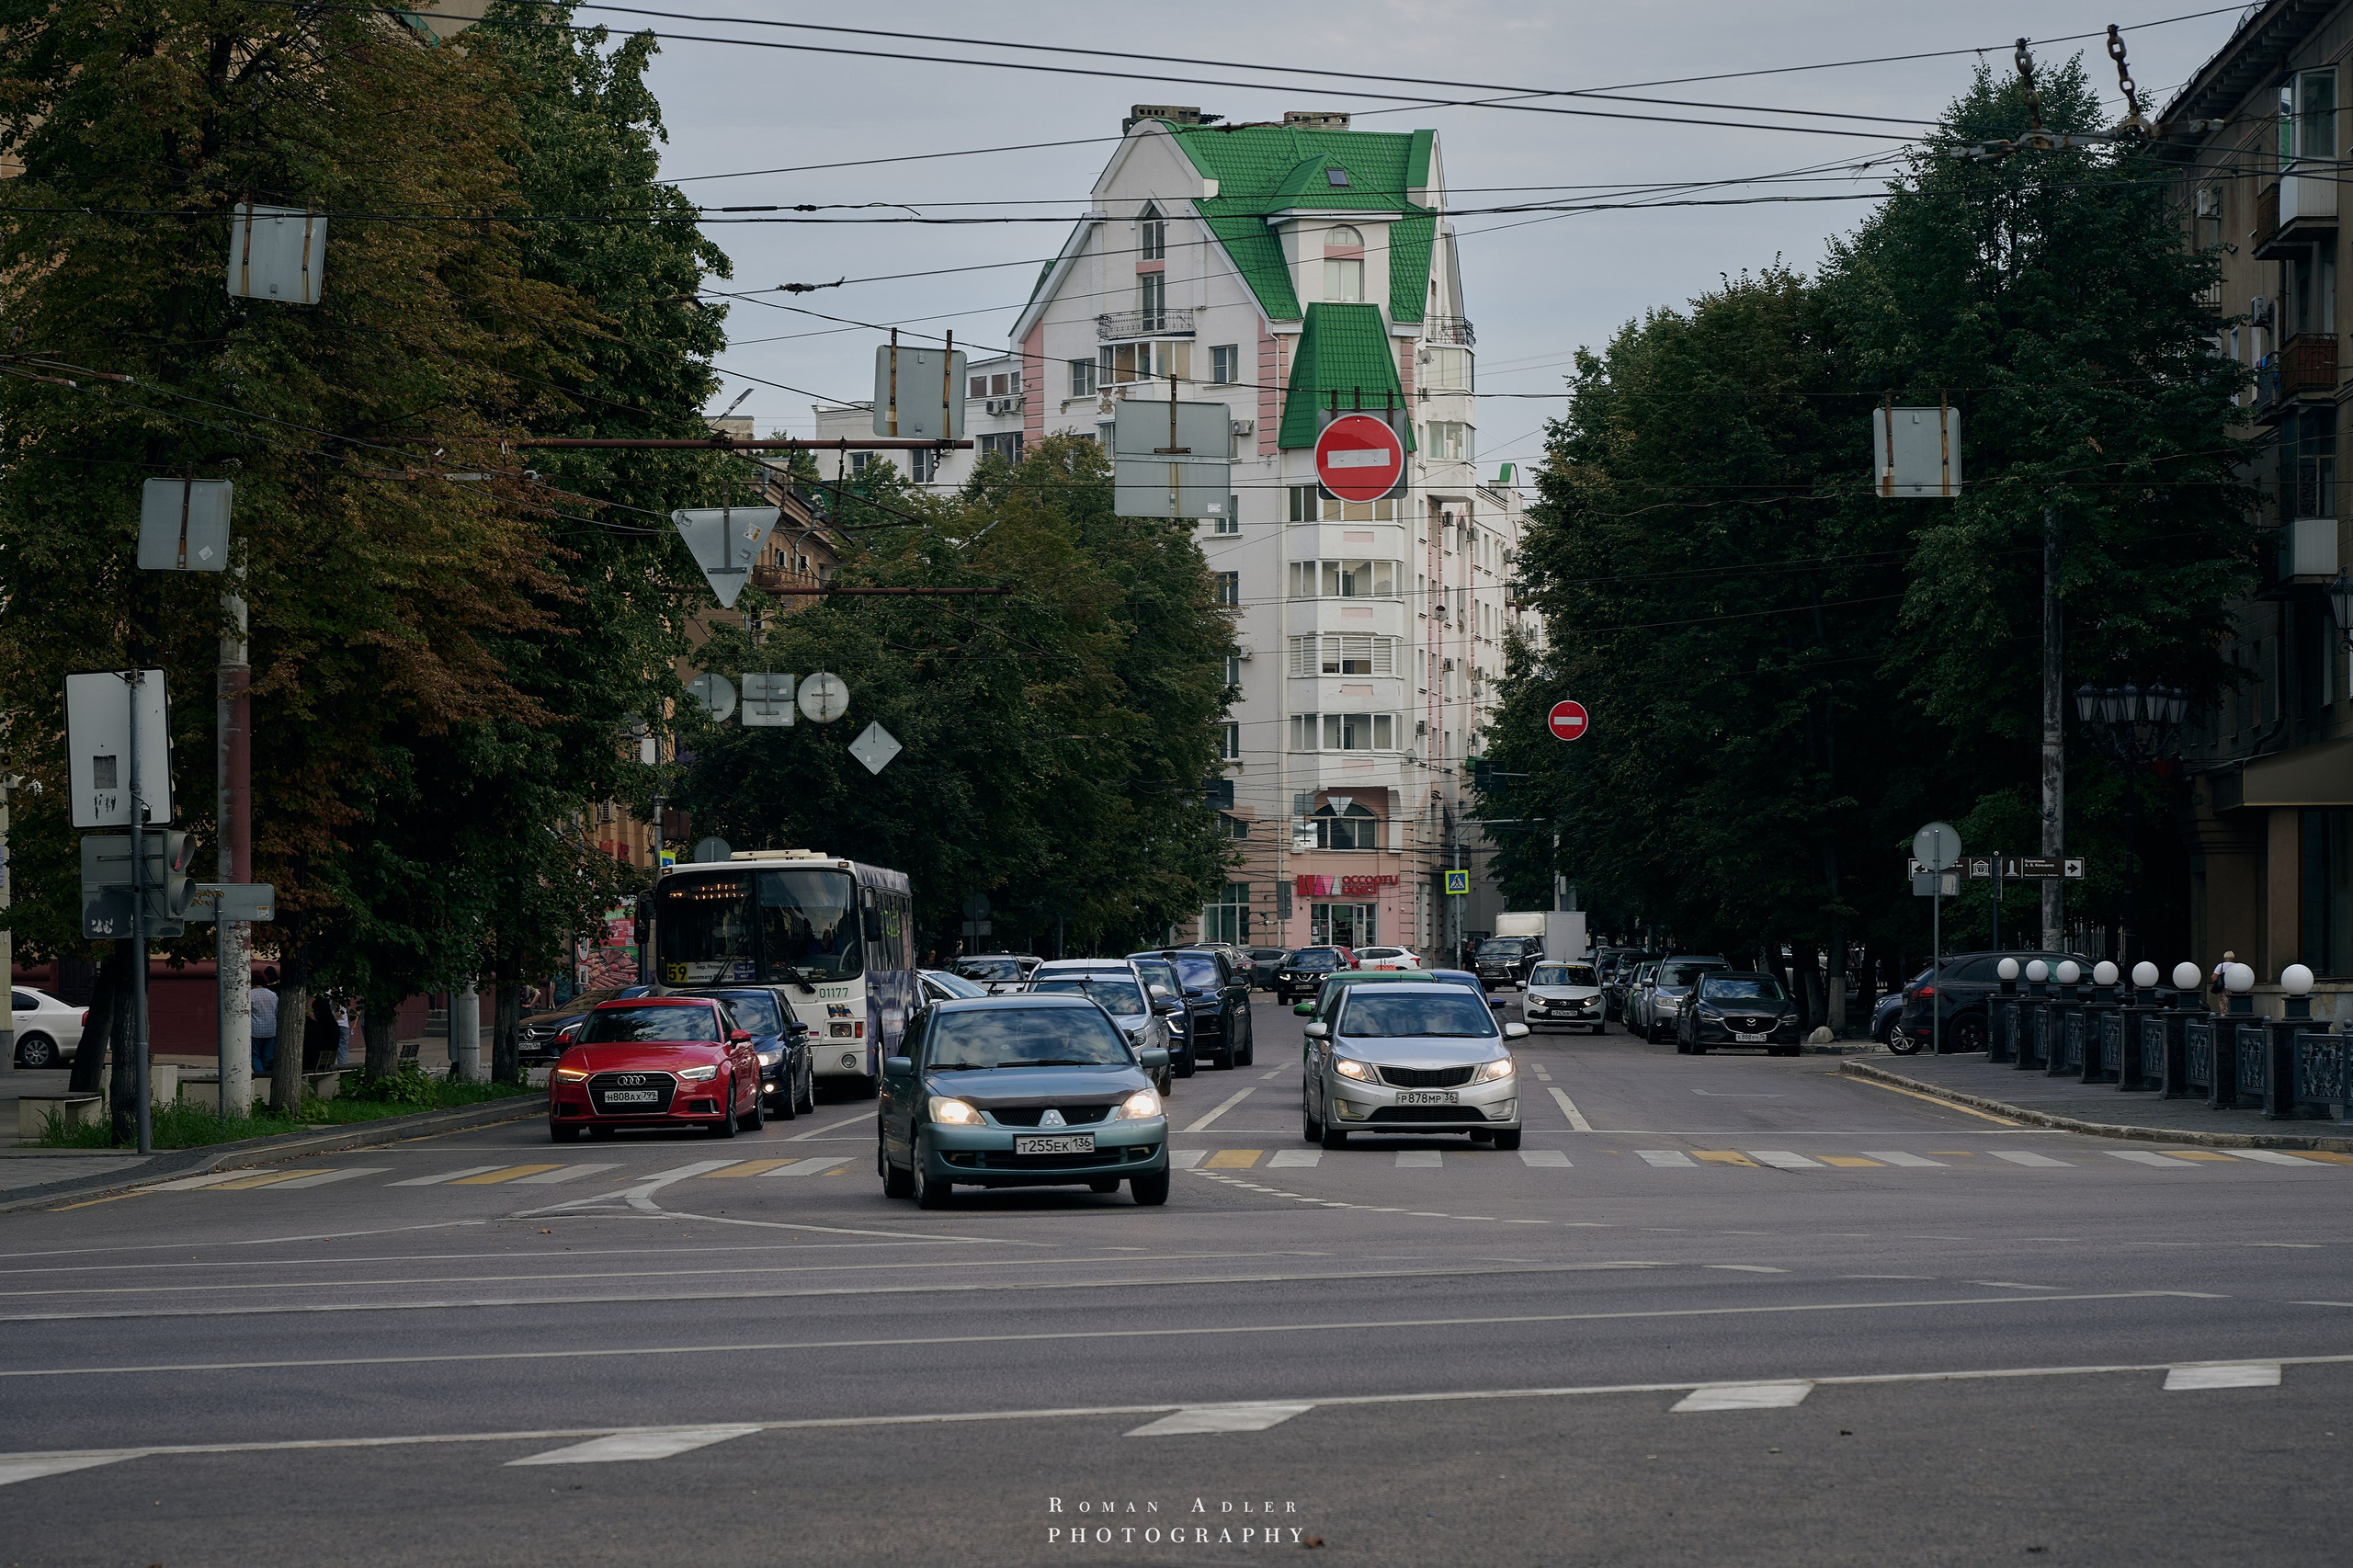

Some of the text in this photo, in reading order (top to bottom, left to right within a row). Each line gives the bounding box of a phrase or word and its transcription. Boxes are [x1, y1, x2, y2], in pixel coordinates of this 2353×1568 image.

[668, 966, 687, 981] 59
[819, 988, 848, 998] 01177
[1021, 1138, 1090, 1152] Т255ЕК 136
